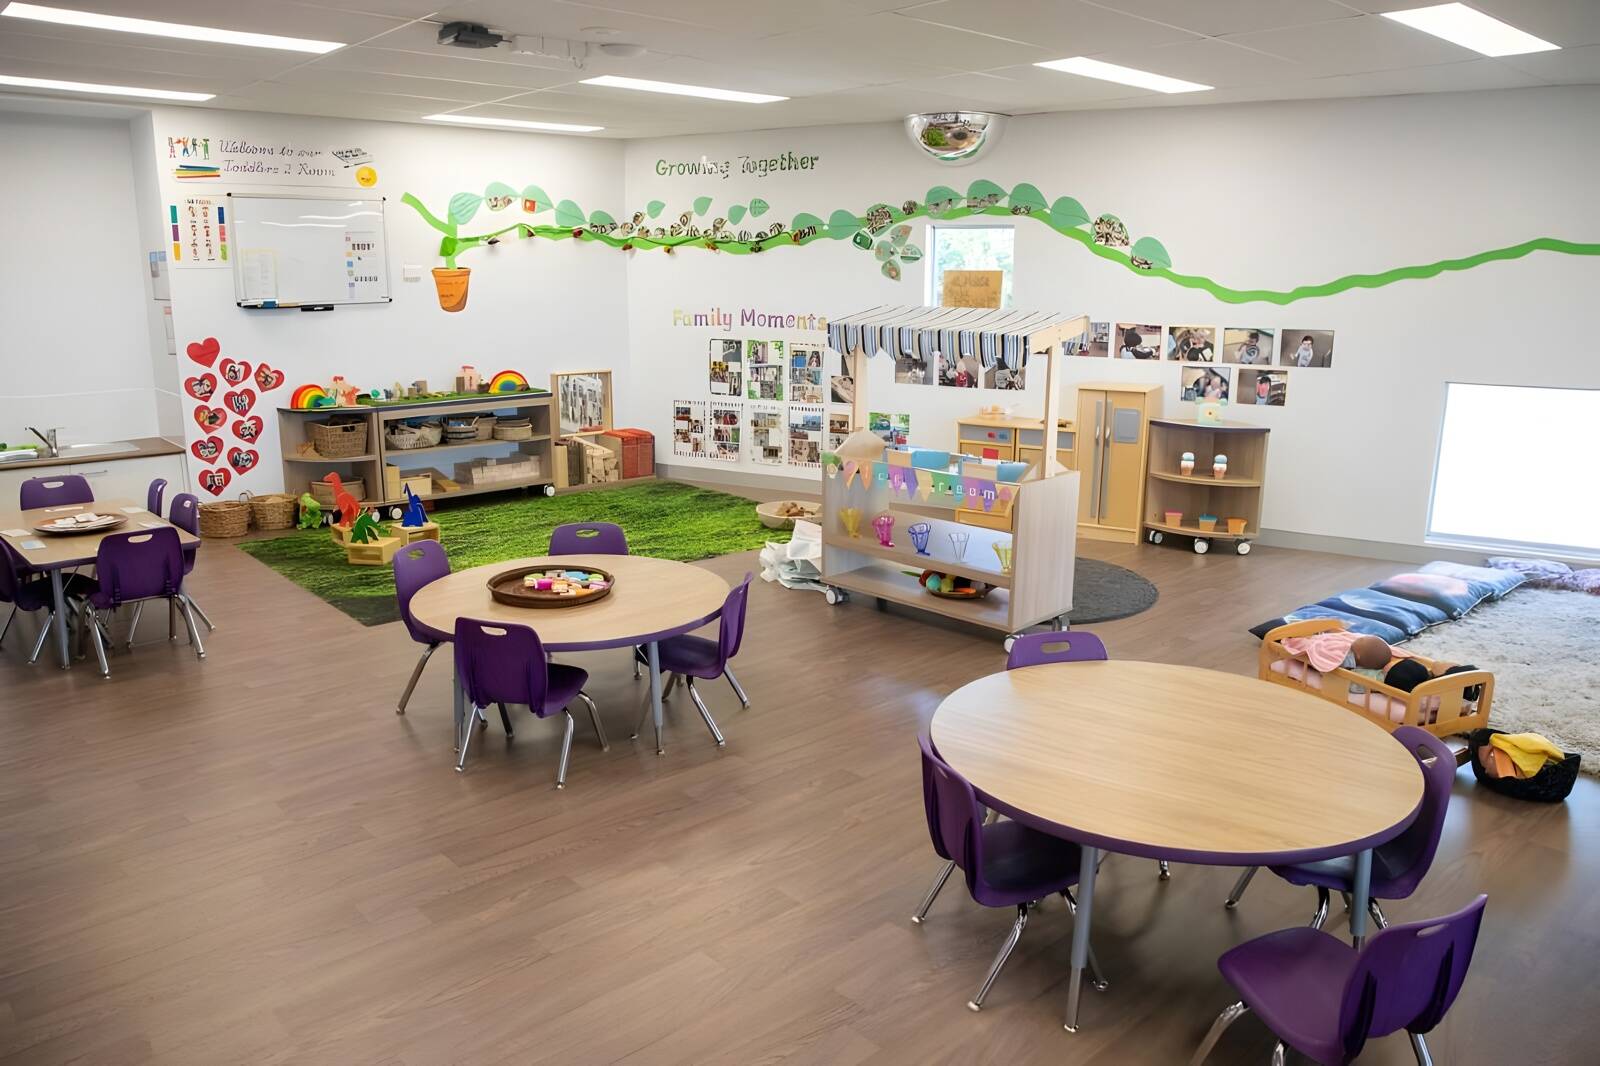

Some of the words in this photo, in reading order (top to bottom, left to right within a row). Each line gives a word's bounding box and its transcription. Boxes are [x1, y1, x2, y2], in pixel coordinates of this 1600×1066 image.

[655, 157, 730, 179] Growing
[737, 151, 820, 178] Together
[672, 307, 732, 332] Family
[740, 308, 828, 331] Moments
